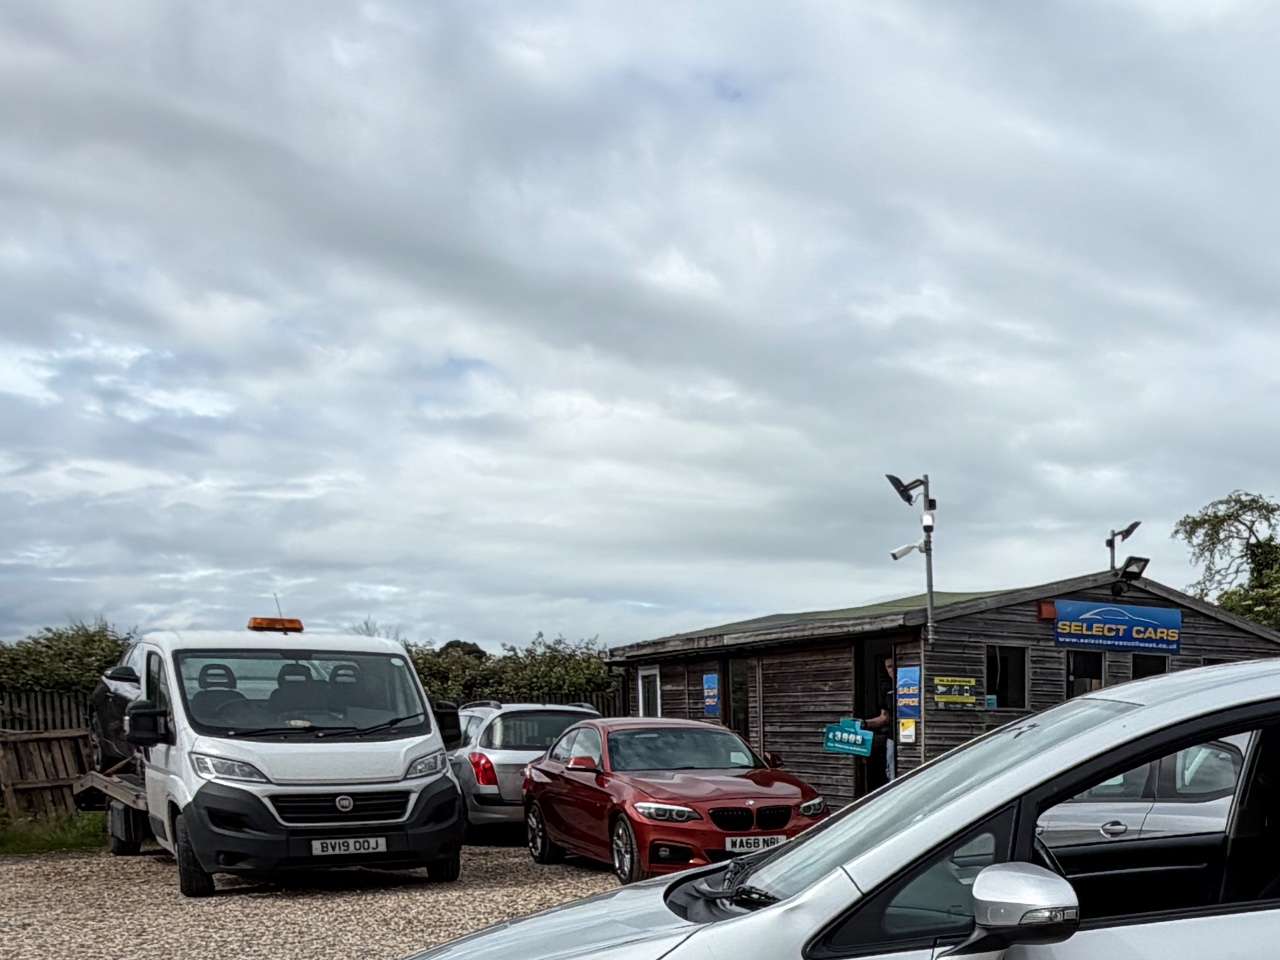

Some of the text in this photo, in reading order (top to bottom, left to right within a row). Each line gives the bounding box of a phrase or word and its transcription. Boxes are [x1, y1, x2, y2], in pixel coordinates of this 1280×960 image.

[1057, 621, 1180, 641] SELECT CARS
[320, 840, 350, 853] BV19
[730, 837, 760, 849] WA68
